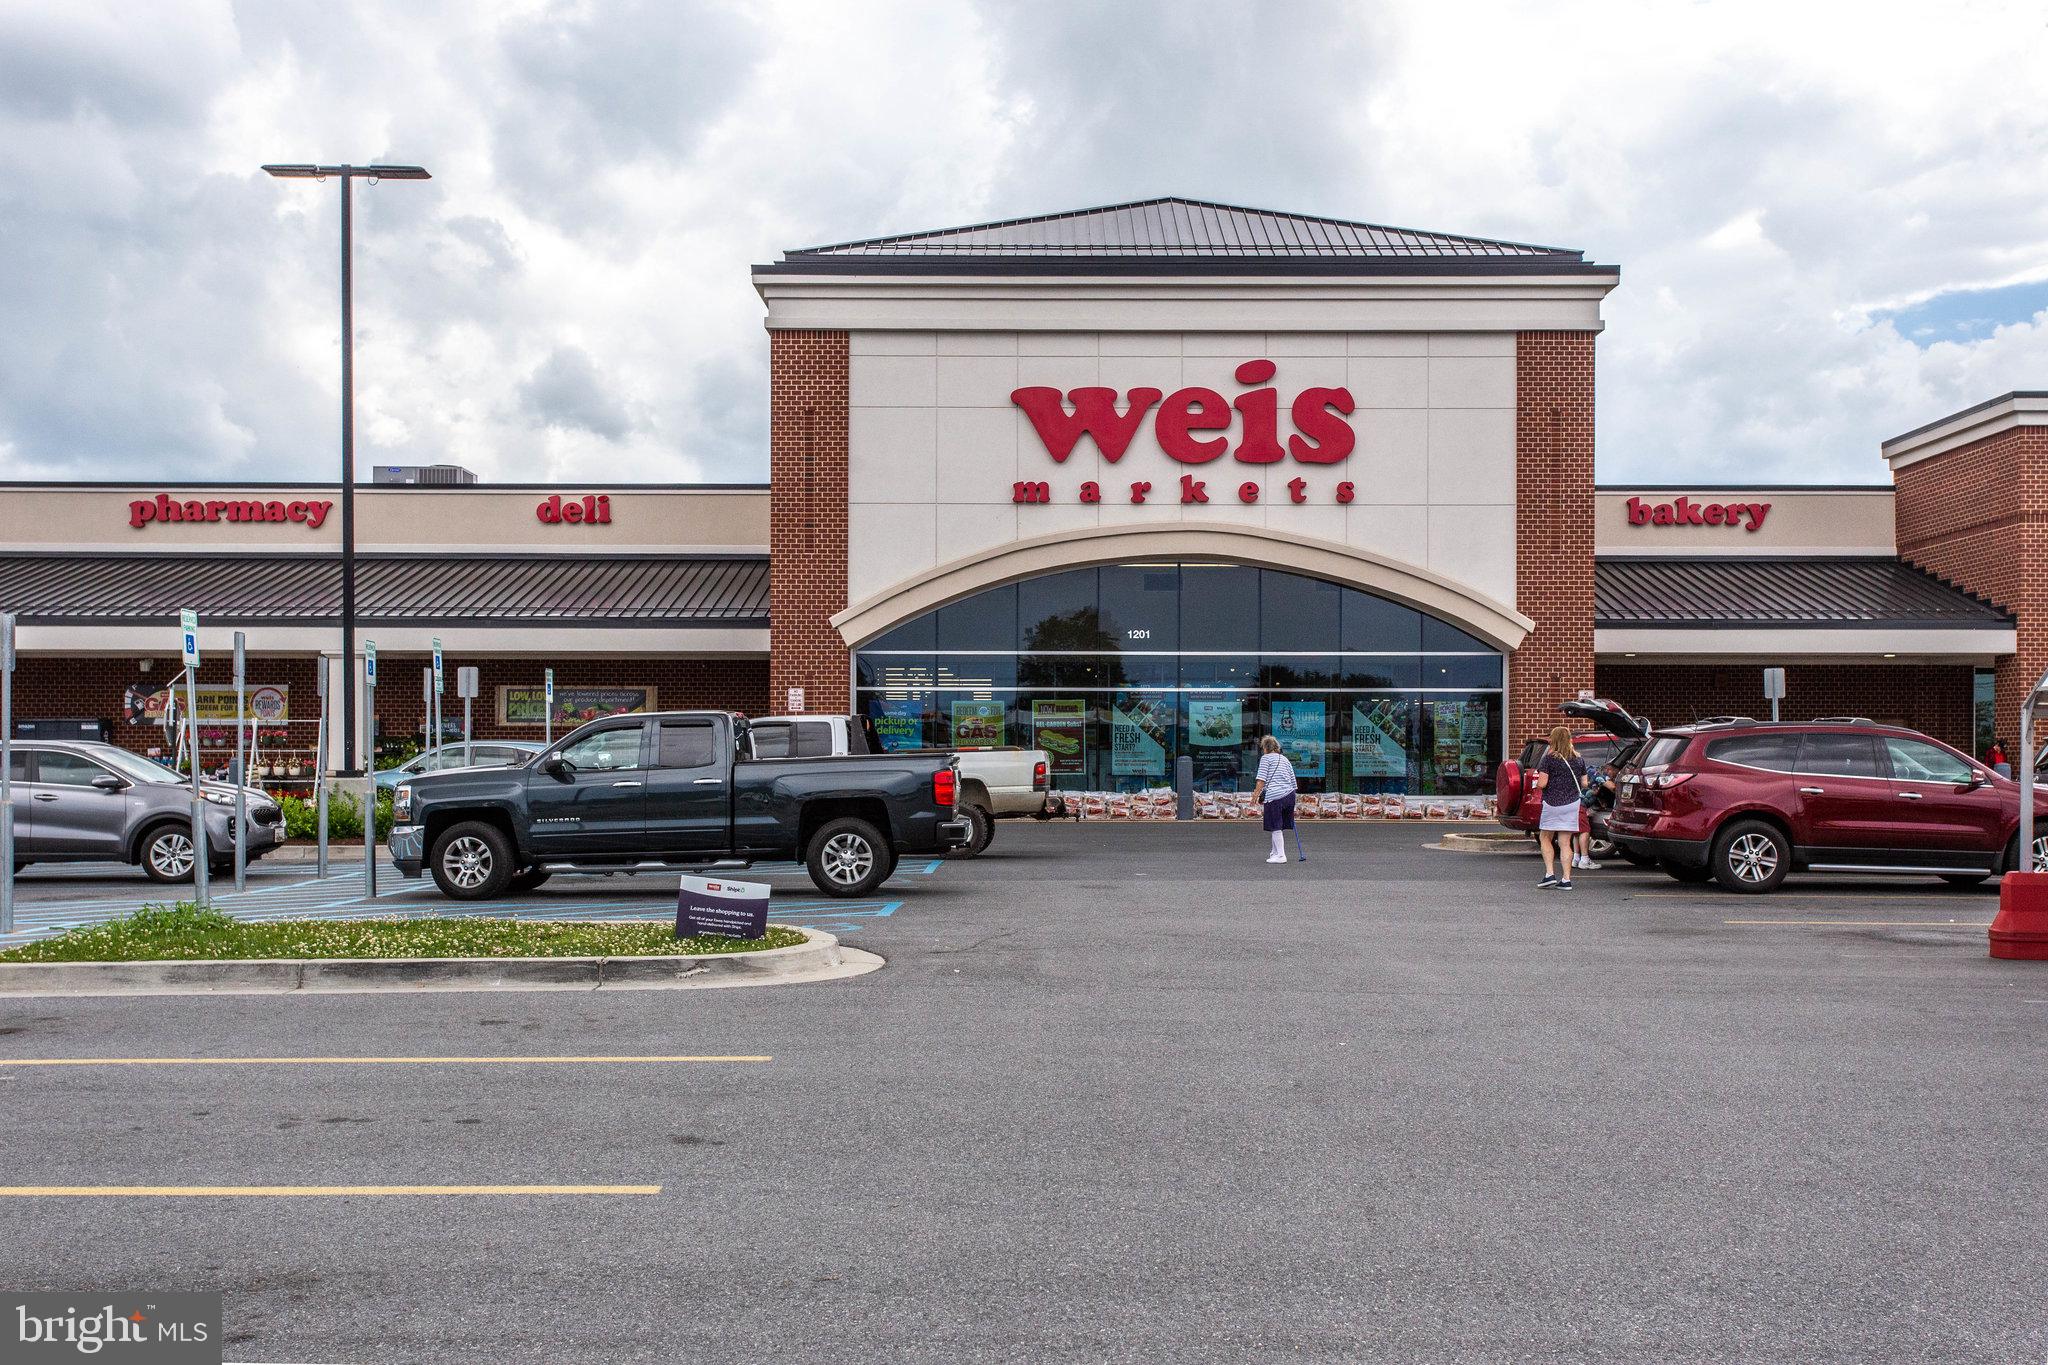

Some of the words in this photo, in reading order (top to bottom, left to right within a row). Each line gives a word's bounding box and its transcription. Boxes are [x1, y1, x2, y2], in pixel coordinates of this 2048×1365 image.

[1011, 359, 1355, 464] weis
[1012, 474, 1355, 504] markets
[129, 494, 332, 528] pharmacy
[536, 494, 611, 524] deli
[1627, 496, 1772, 531] bakery
[1127, 629, 1150, 639] 1201
[508, 702, 546, 716] PRICE
[1296, 711, 1320, 721] JUNE
[874, 717, 907, 726] pickup
[876, 726, 915, 736] delivery
[956, 724, 998, 739] GAS
[1114, 724, 1130, 733] NEED
[1130, 724, 1135, 733] A
[1354, 725, 1371, 733] NEED
[1371, 724, 1376, 733] A
[1114, 732, 1141, 743] FRESH
[1354, 733, 1381, 744] FRESH
[1114, 744, 1136, 752] START?
[1354, 744, 1377, 753] START?
[716, 908, 740, 917] shopping
